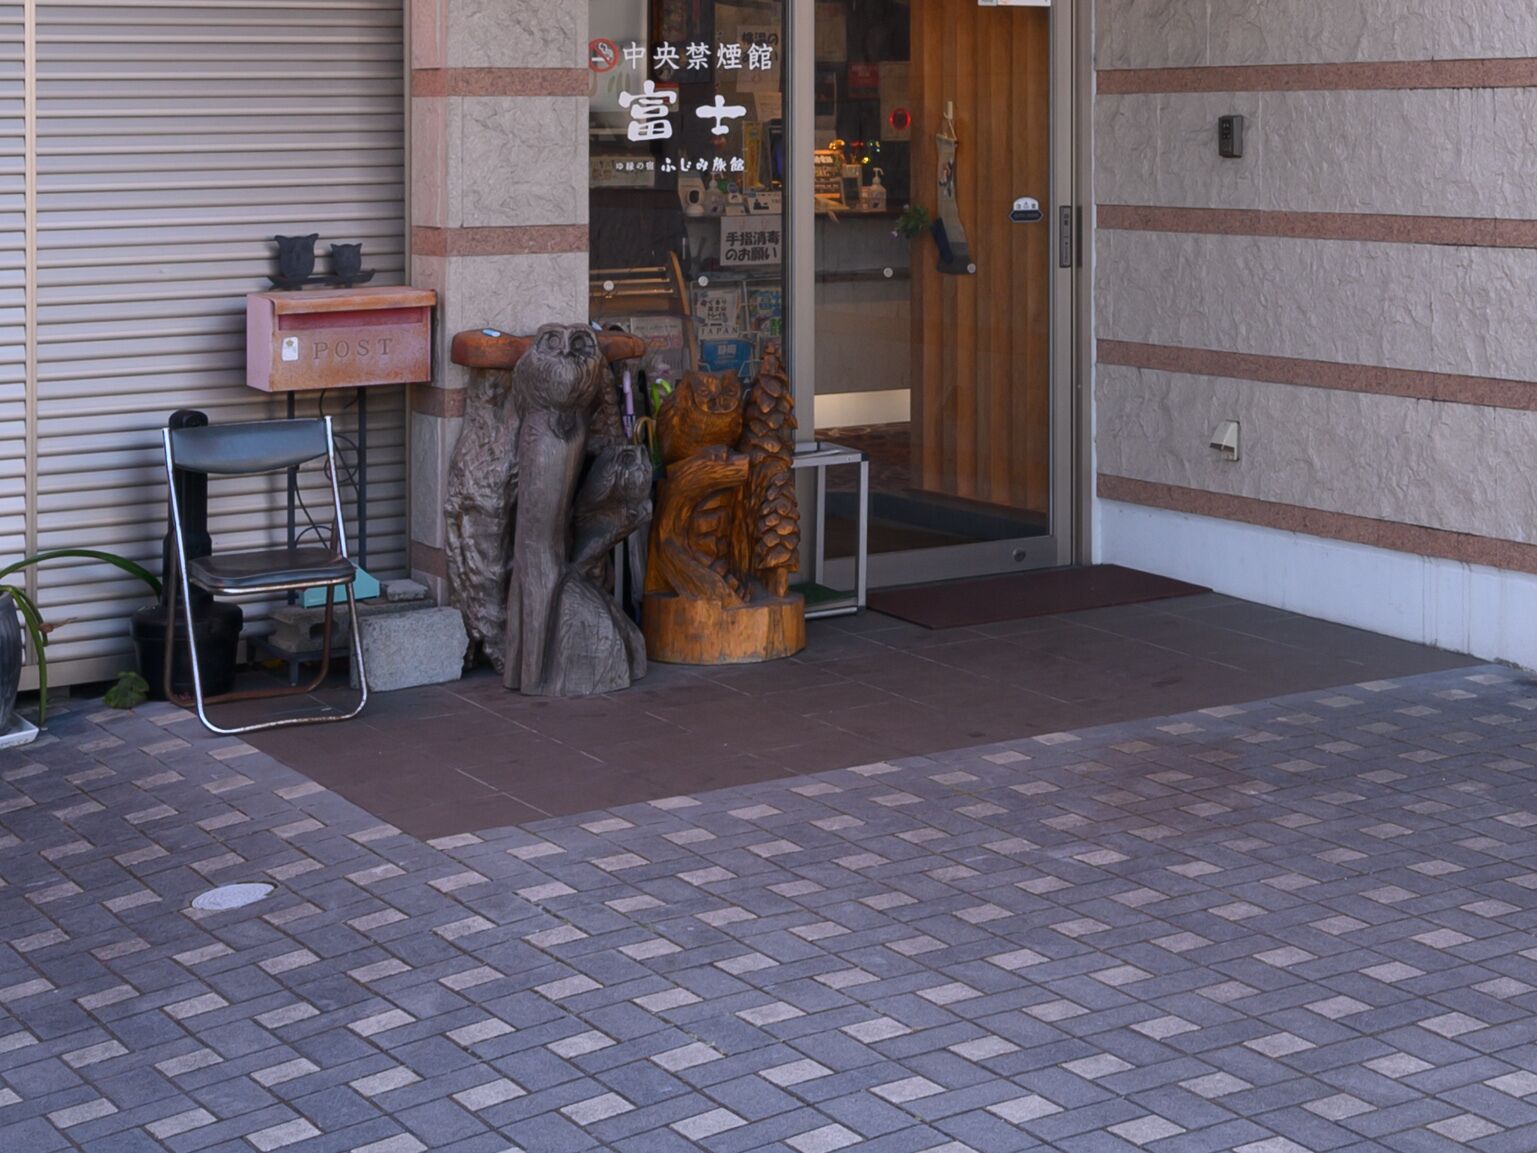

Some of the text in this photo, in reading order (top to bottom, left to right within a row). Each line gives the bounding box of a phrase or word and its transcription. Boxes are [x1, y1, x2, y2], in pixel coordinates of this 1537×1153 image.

[622, 41, 774, 71] 中央禁煙館
[618, 79, 747, 143] 富士
[661, 156, 745, 173] ふじみ旅館
[725, 231, 780, 247] 手指消毒
[724, 246, 778, 262] のお願い
[312, 338, 394, 360] POST
